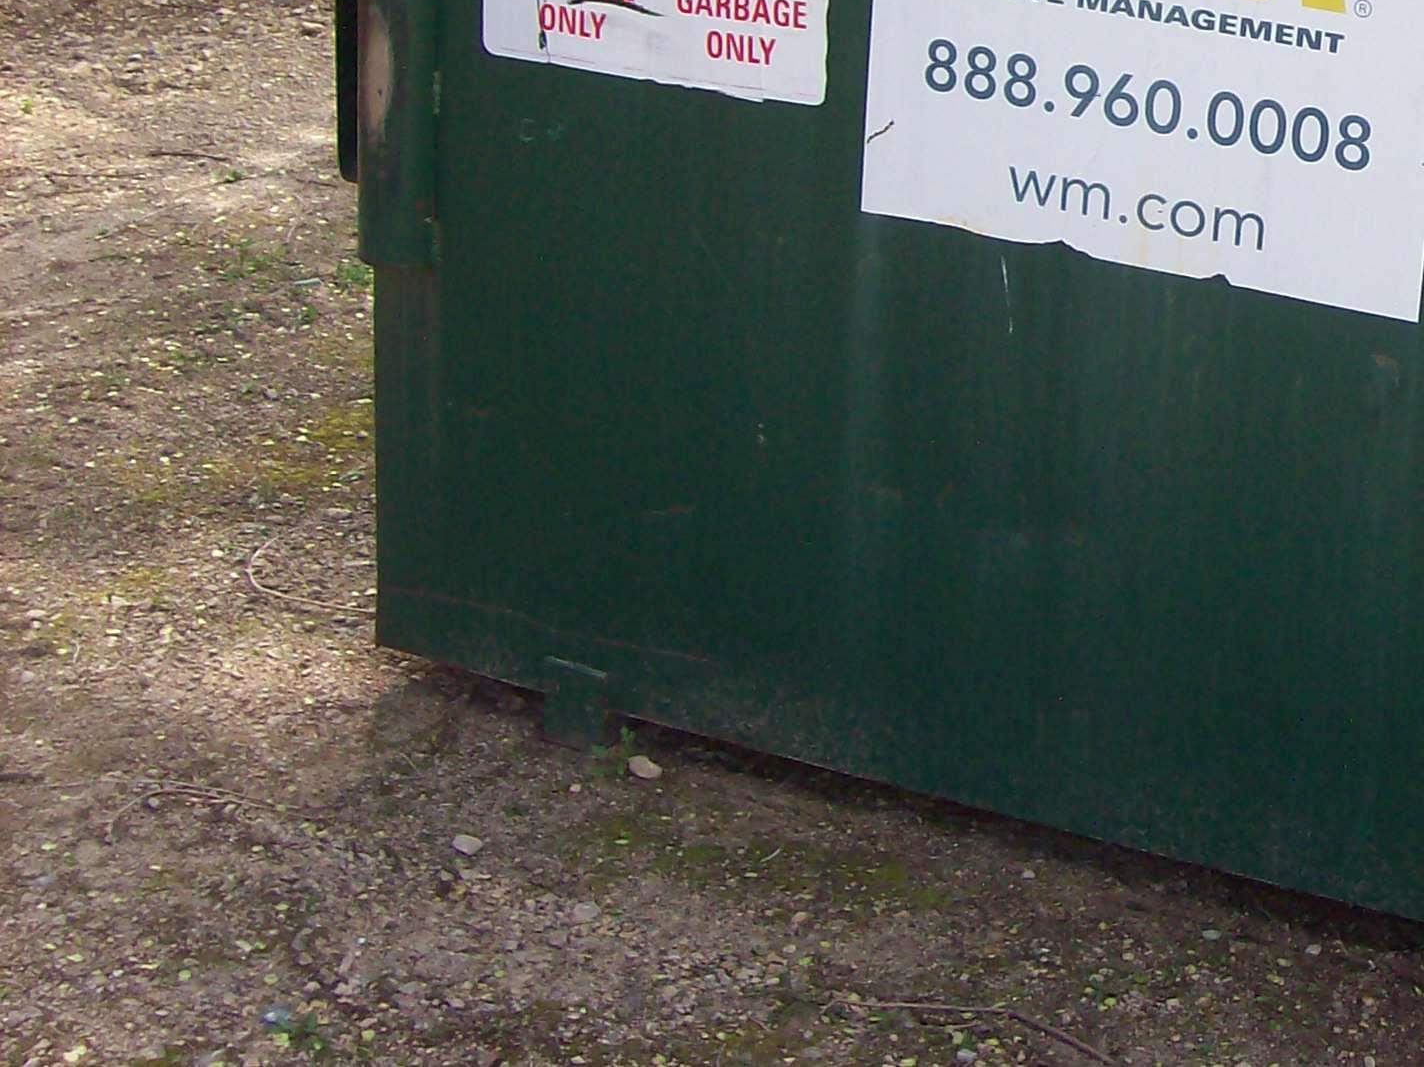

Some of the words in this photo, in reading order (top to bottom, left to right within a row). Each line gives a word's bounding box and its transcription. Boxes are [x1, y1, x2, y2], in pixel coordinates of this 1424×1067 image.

[540, 3, 607, 40] ONLY
[706, 30, 777, 66] ONLY
[924, 38, 1372, 171] 888.960.0008
[1008, 165, 1266, 250] wm.com
